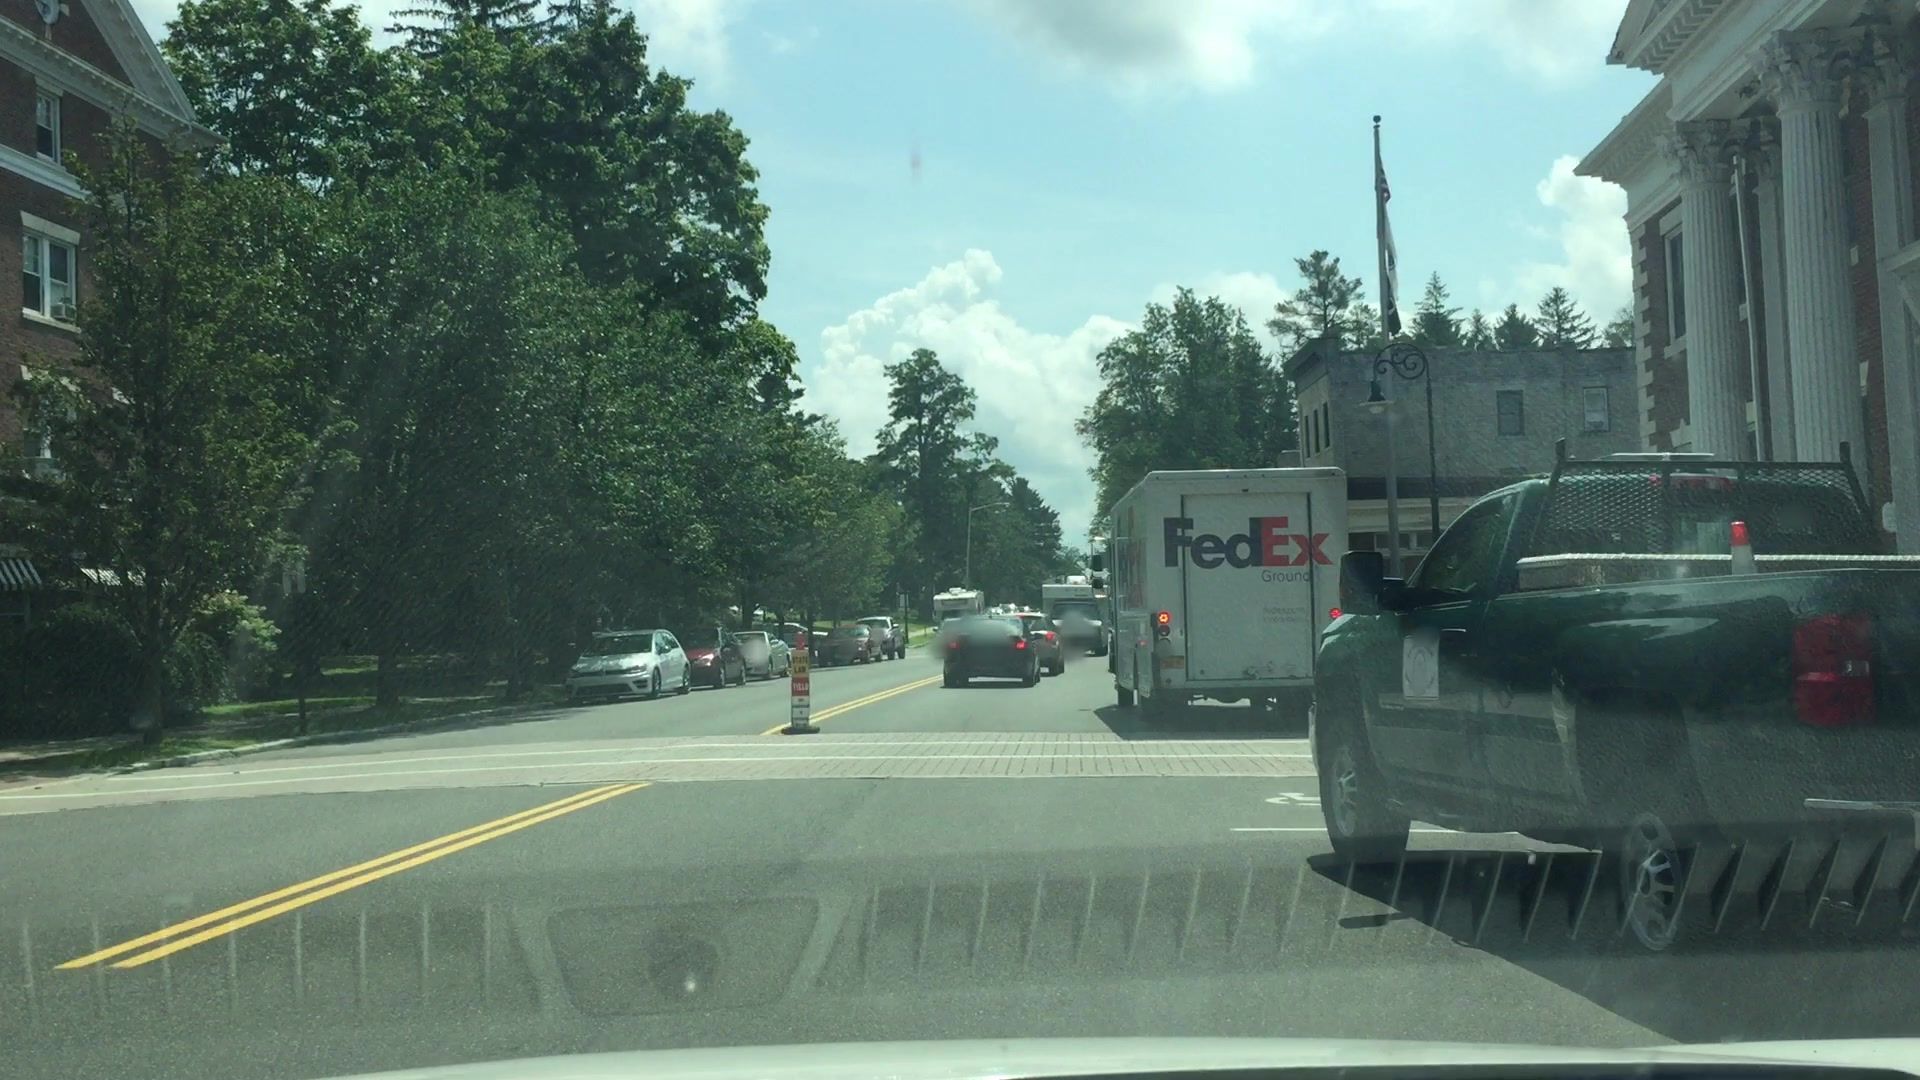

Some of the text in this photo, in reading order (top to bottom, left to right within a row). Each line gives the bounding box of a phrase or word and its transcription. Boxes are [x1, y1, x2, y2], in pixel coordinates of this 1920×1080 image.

[1164, 517, 1333, 568] FedEx
[793, 666, 806, 674] LAW
[793, 682, 808, 691] YIELD
